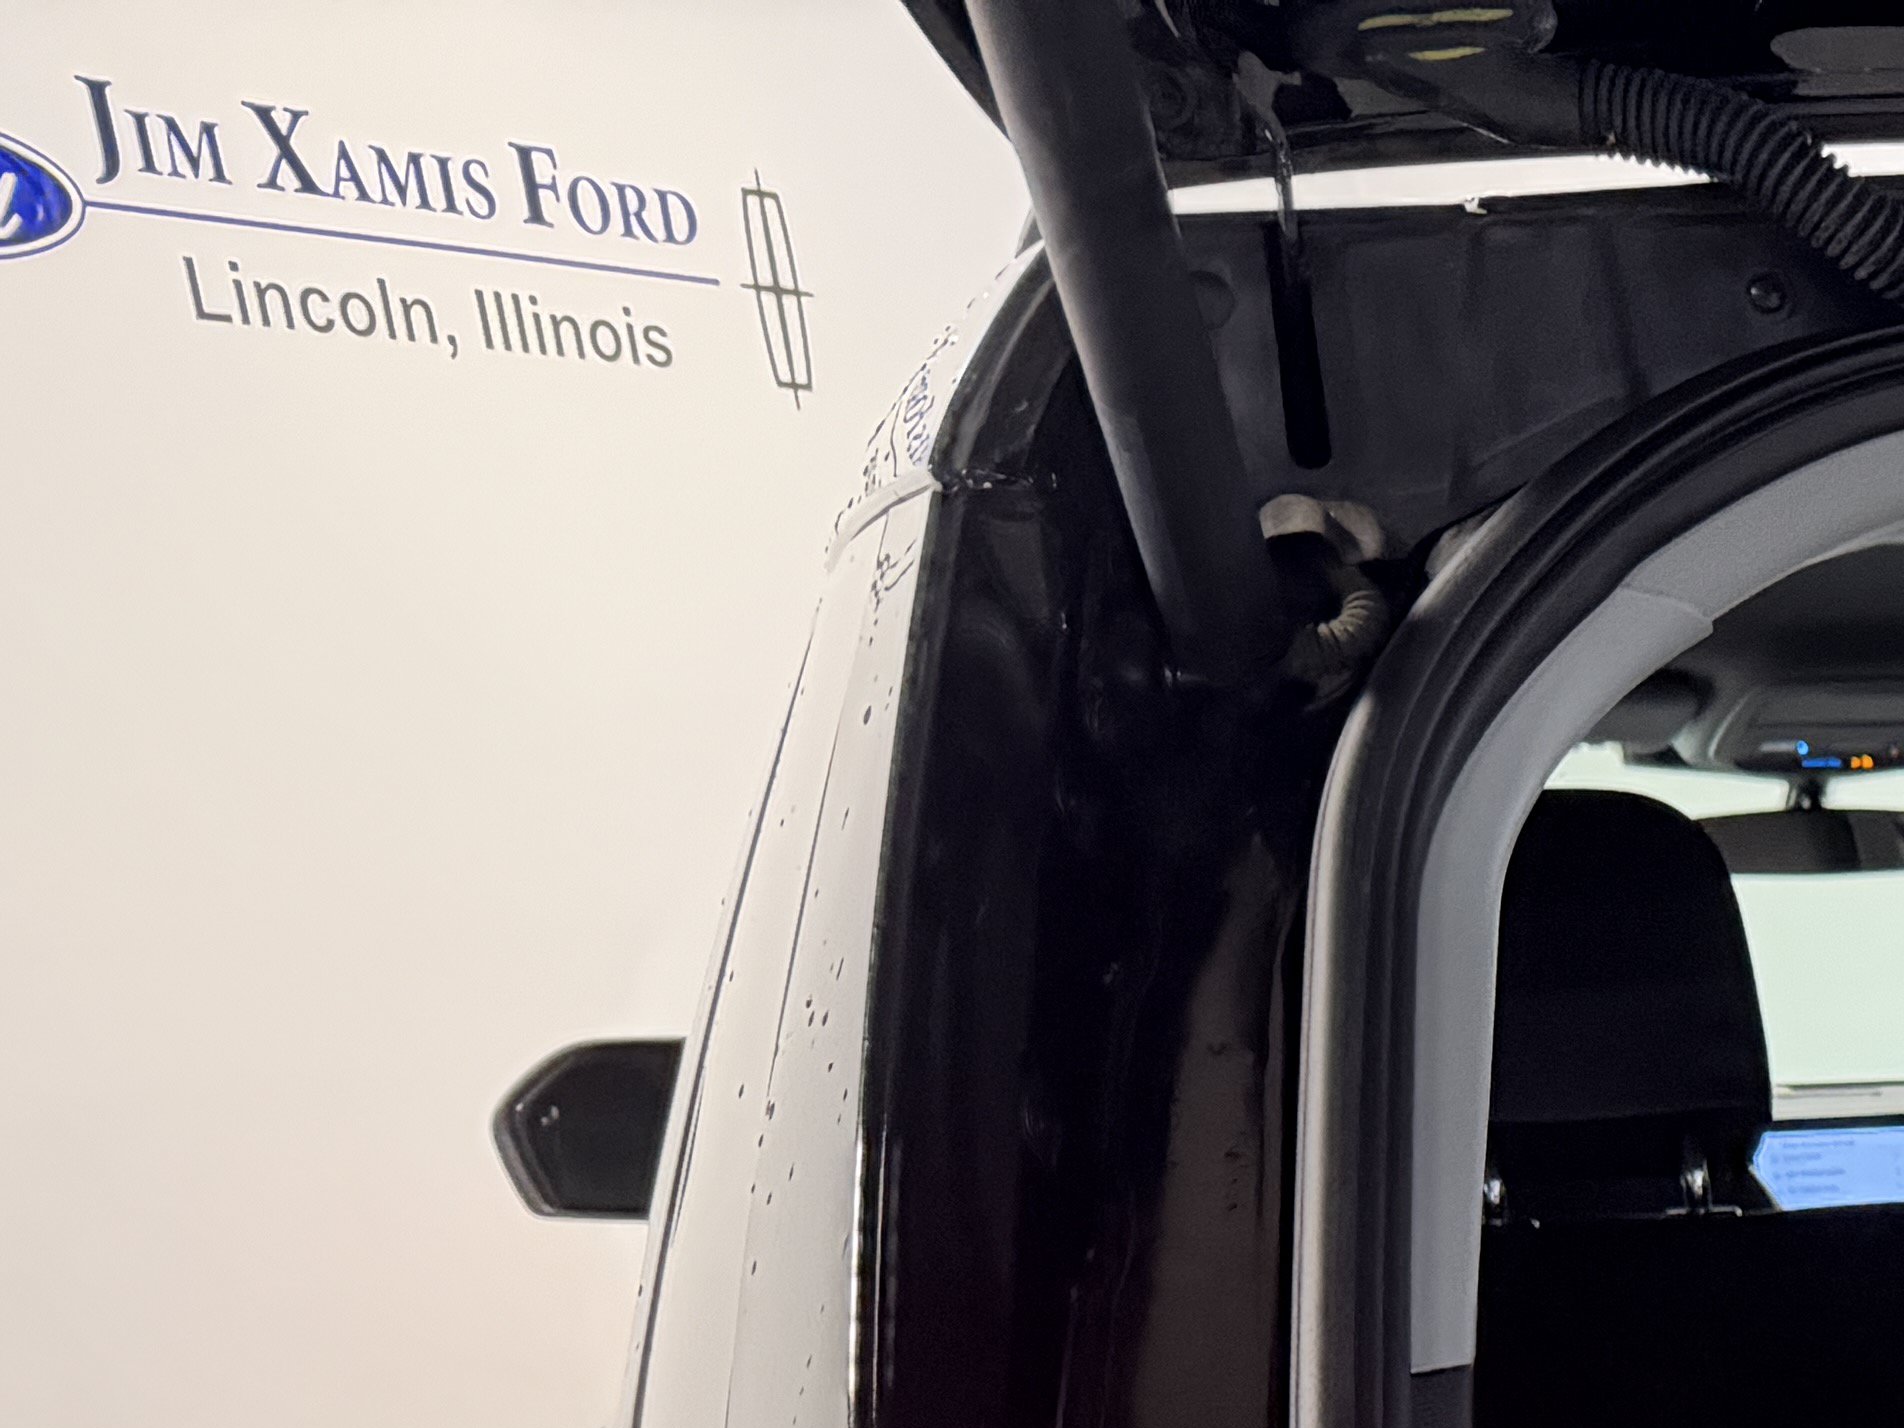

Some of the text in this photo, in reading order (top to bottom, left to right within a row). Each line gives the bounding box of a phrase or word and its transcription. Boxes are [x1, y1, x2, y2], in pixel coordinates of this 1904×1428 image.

[73, 74, 699, 246] JIM XAMIS FORD
[182, 256, 675, 369] Lincoln, Illinois
